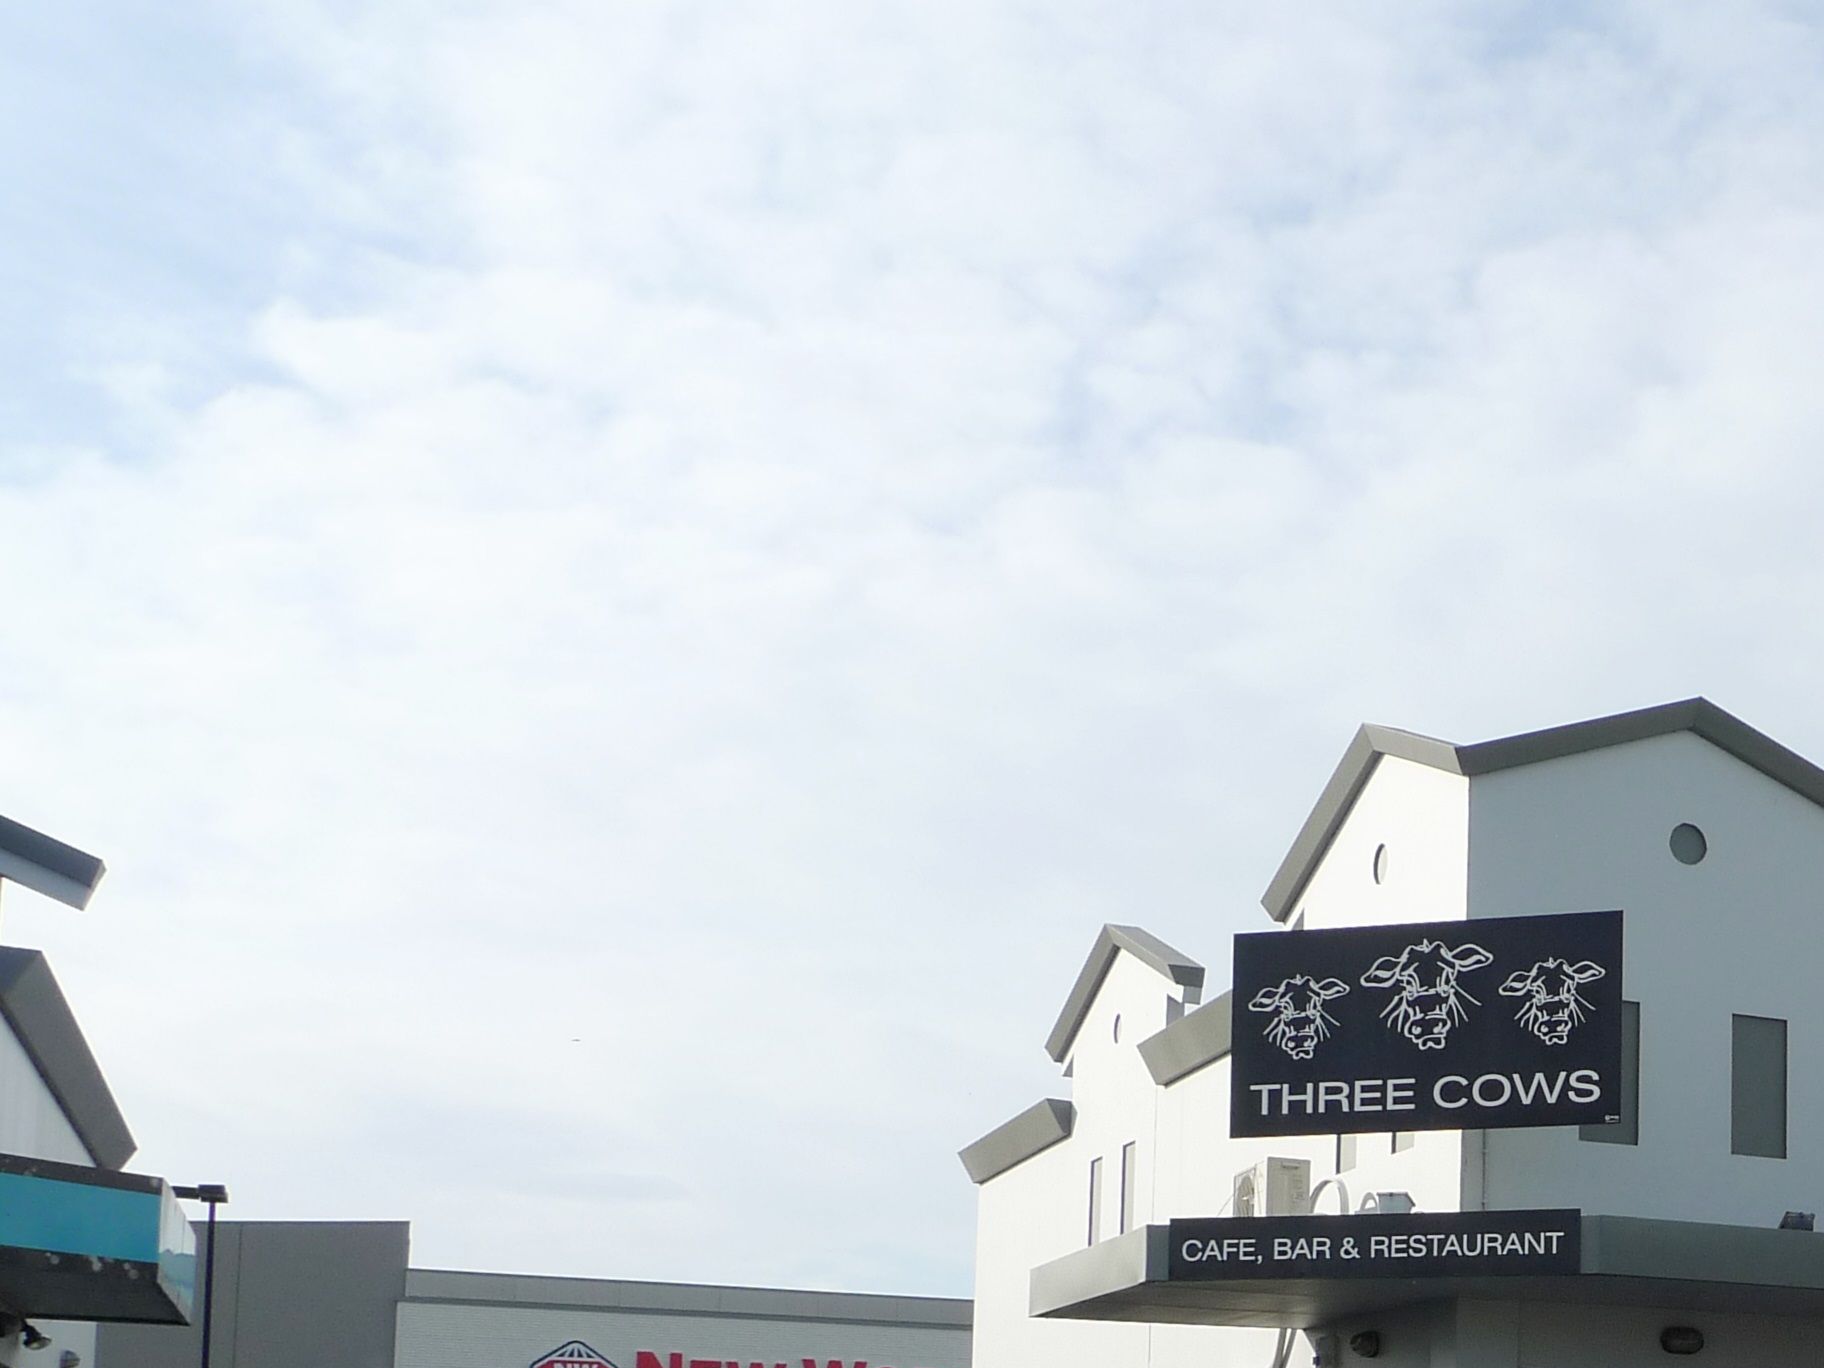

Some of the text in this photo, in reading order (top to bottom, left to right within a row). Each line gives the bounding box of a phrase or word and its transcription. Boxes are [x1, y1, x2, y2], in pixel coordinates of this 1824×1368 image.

[1249, 1069, 1602, 1116] THREE COWS
[1181, 1231, 1564, 1265] CAFE, BAR & RESTAURANT
